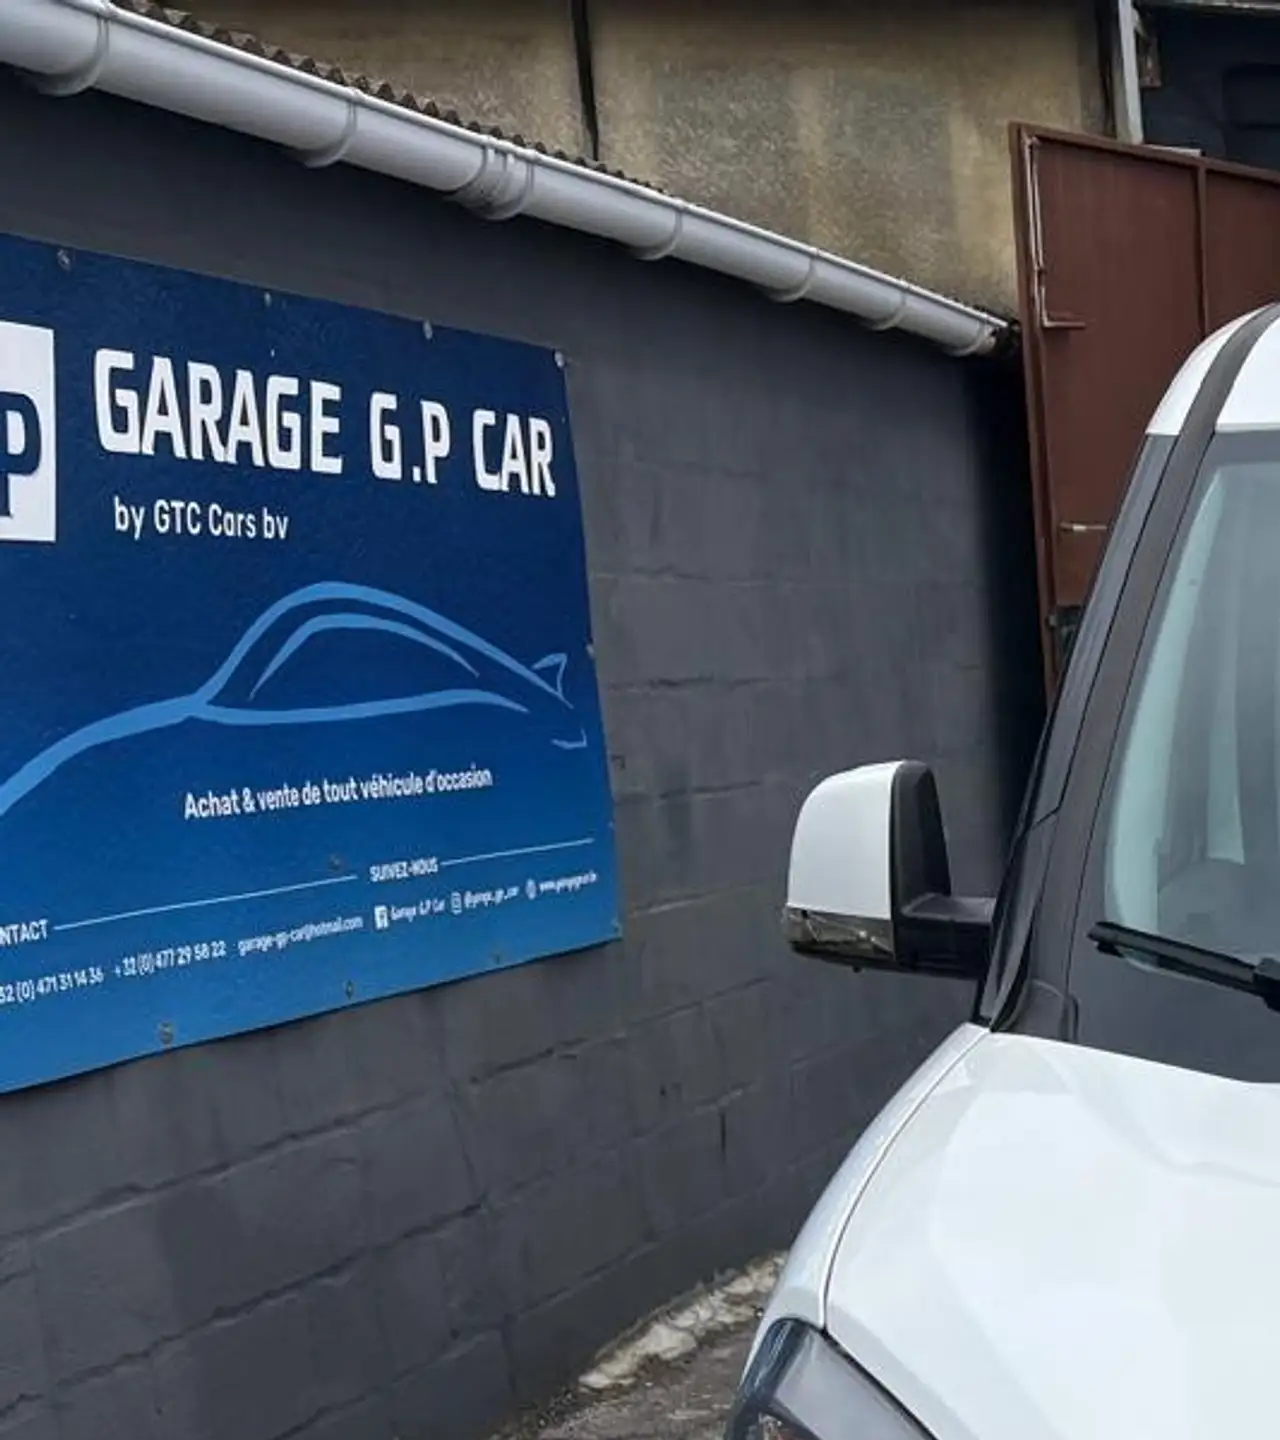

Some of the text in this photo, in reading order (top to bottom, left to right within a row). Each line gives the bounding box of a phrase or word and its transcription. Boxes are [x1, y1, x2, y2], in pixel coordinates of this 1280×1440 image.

[95, 348, 556, 497] GARAGE G.P CAR
[114, 495, 288, 541] by GTC Cars bv
[184, 762, 493, 820] Achat & vente de tout véhicule d'occasion
[16, 979, 35, 1004] (0)
[59, 973, 73, 990] 31
